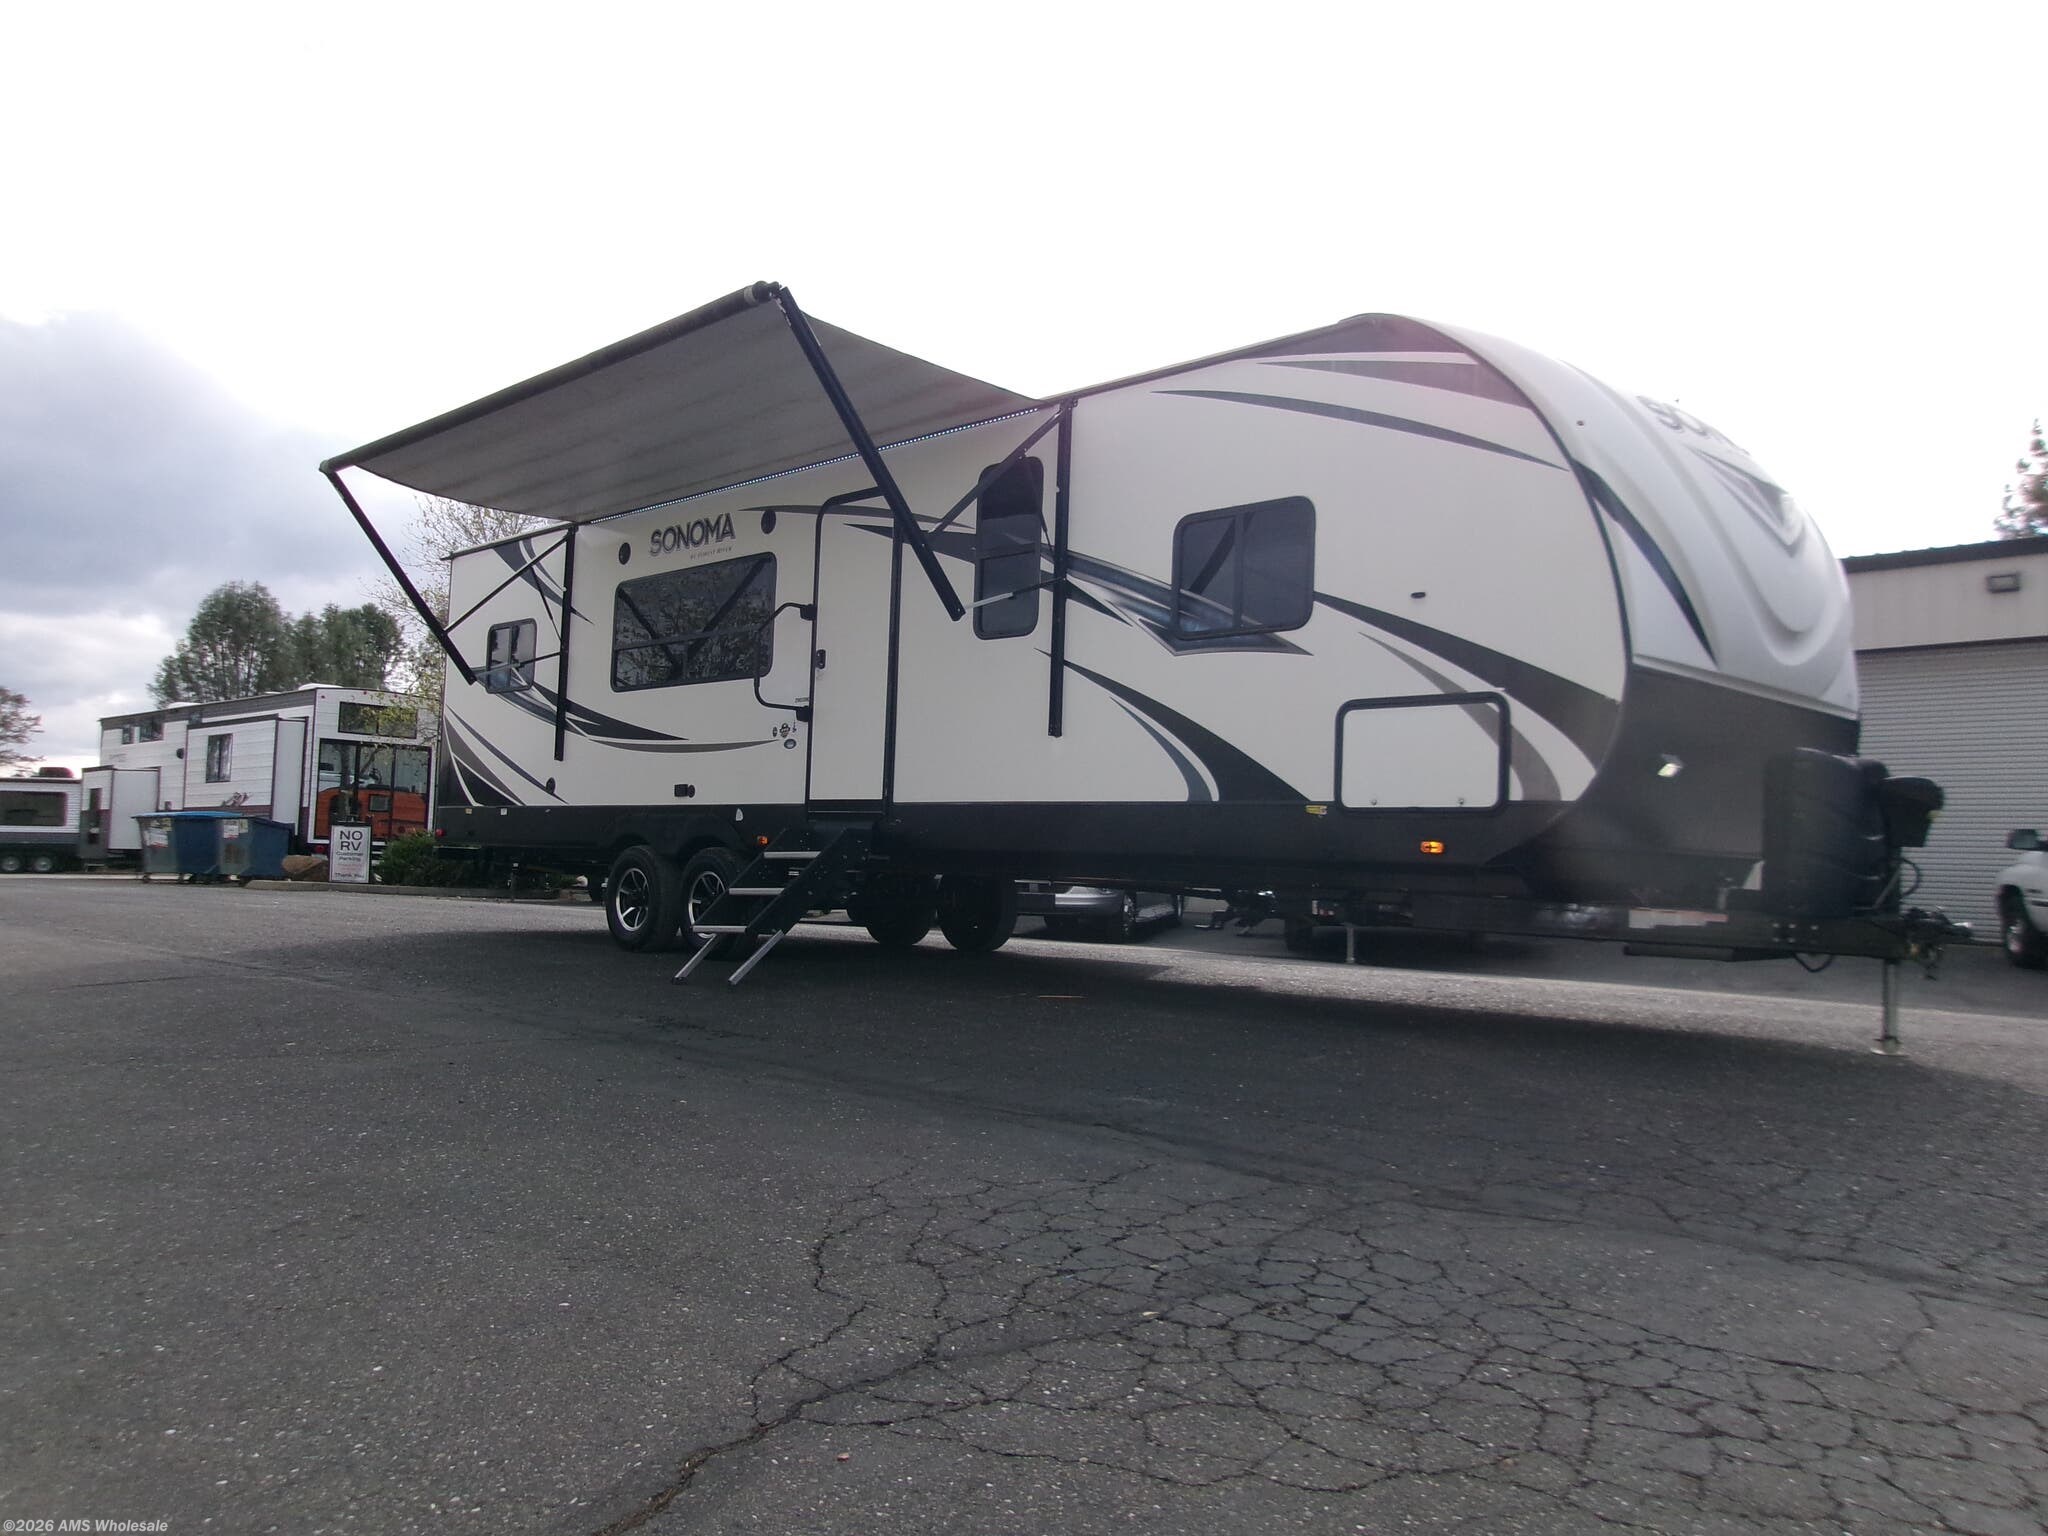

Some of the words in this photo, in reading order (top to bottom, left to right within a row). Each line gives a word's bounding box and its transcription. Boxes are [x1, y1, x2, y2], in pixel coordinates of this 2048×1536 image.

[650, 512, 736, 557] SONOMA
[340, 830, 363, 840] NO
[340, 841, 362, 851] RV
